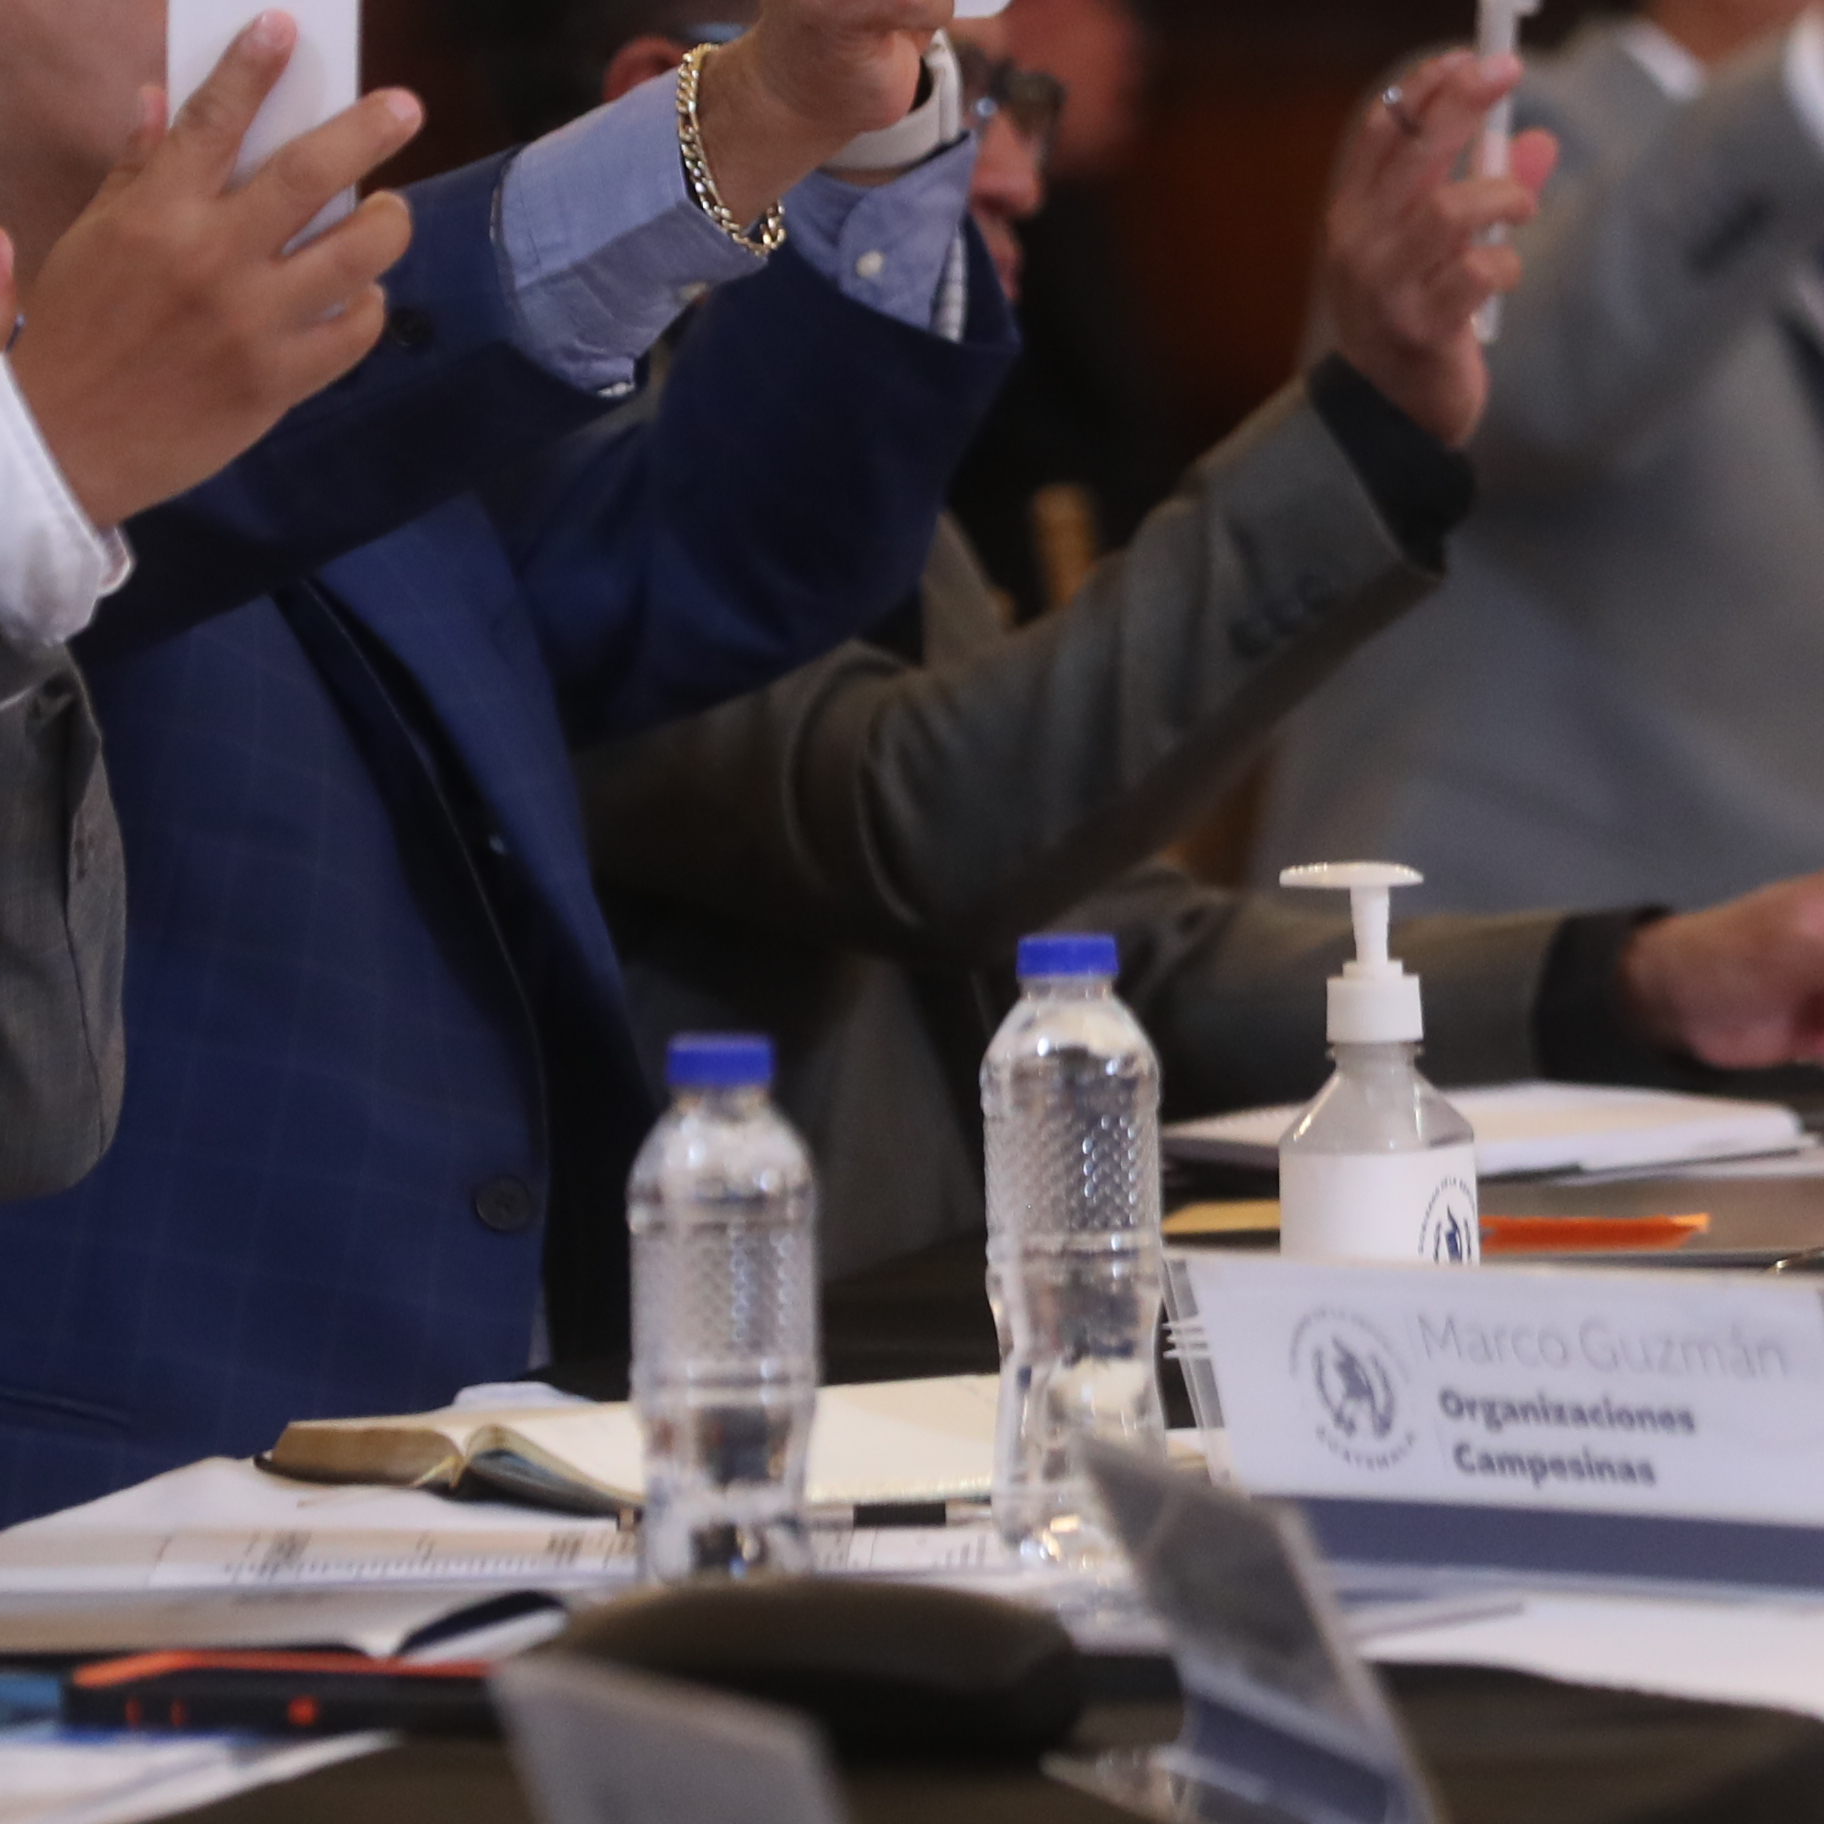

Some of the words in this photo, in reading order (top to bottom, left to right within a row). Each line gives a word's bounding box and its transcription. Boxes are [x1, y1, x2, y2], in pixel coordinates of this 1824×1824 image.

[1417, 1312, 1570, 1372] Marco
[1578, 1312, 1790, 1380] Guzmán
[1437, 1387, 1696, 1434] Organizaciones
[1453, 1440, 1657, 1490] Campesinas
